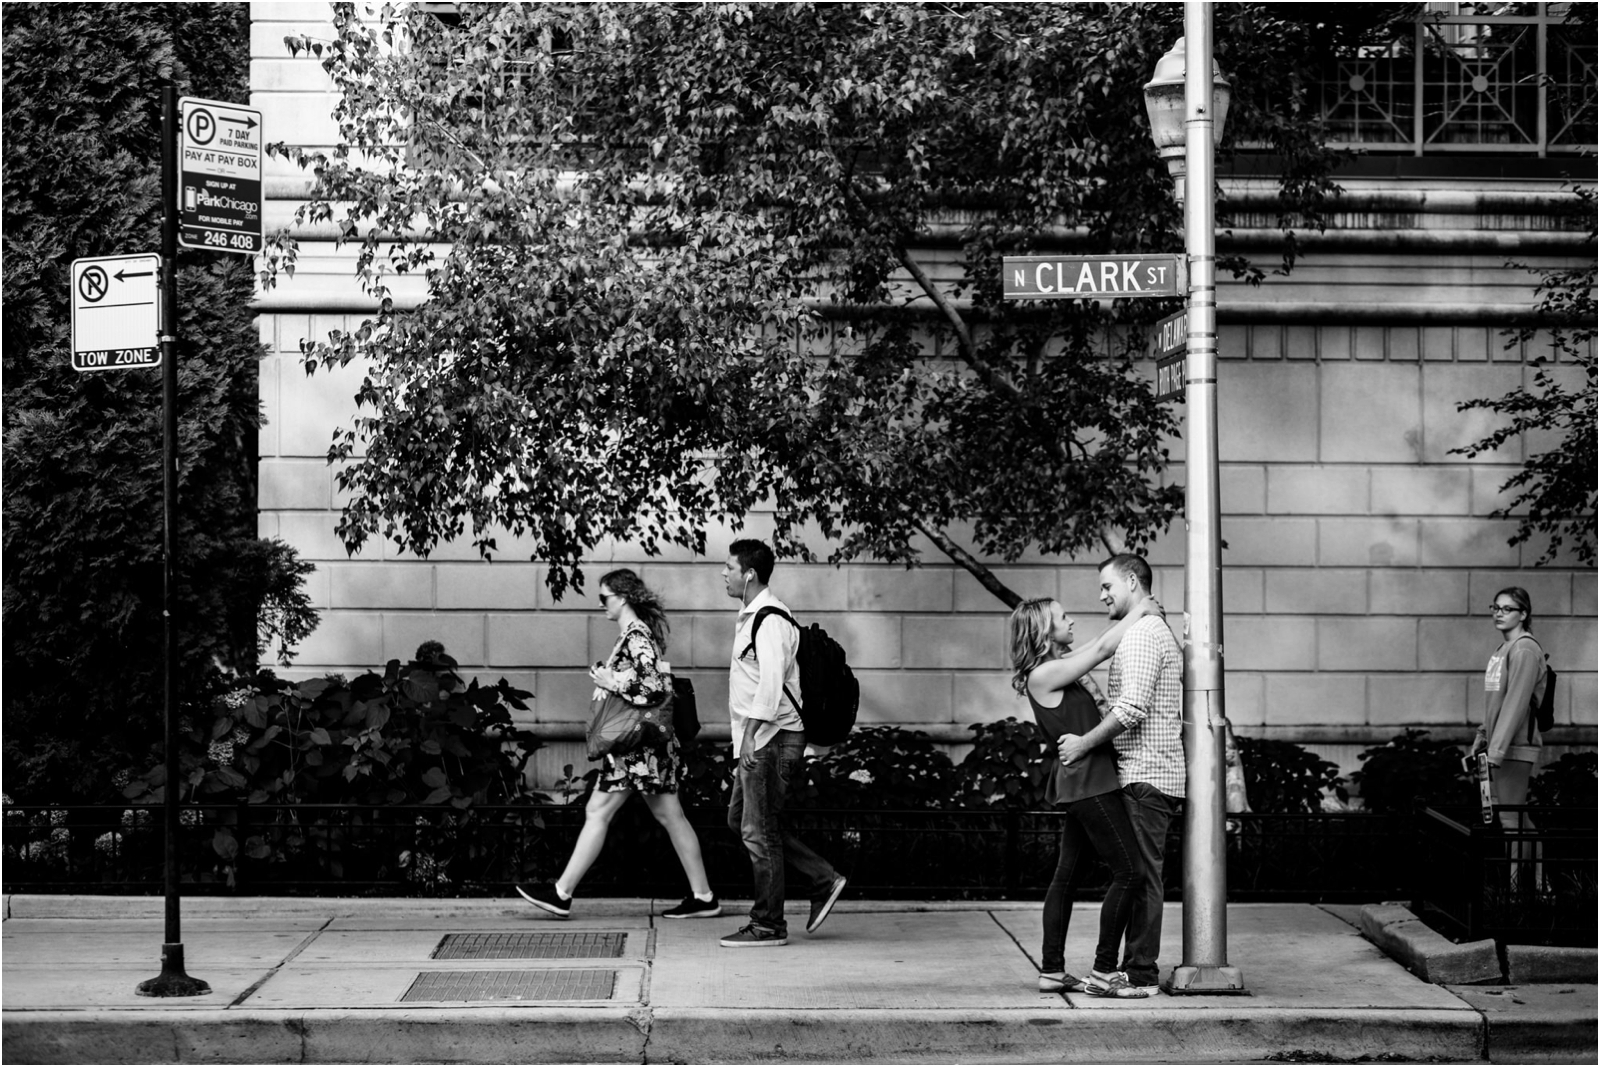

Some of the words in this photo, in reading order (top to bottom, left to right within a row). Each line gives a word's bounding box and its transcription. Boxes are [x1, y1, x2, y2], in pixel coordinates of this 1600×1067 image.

[228, 129, 233, 138] 7
[235, 129, 250, 140] DAY
[219, 138, 233, 147] PAID
[234, 140, 258, 151] PARKING
[185, 150, 202, 161] PAY
[204, 153, 216, 163] AT
[218, 155, 235, 165] PAY
[237, 157, 257, 169] BOX
[205, 180, 220, 188] SIGN
[196, 192, 258, 214] ParkChicago
[198, 215, 211, 223] FOR
[211, 216, 232, 226] MOBILE
[232, 219, 244, 227] PAY
[204, 231, 227, 246] 246
[230, 234, 253, 249] 408
[1014, 269, 1025, 287] N
[1035, 261, 1142, 293] CLARK
[1147, 267, 1167, 285] ST
[78, 351, 108, 366] TOW
[115, 348, 153, 364] ZONE
